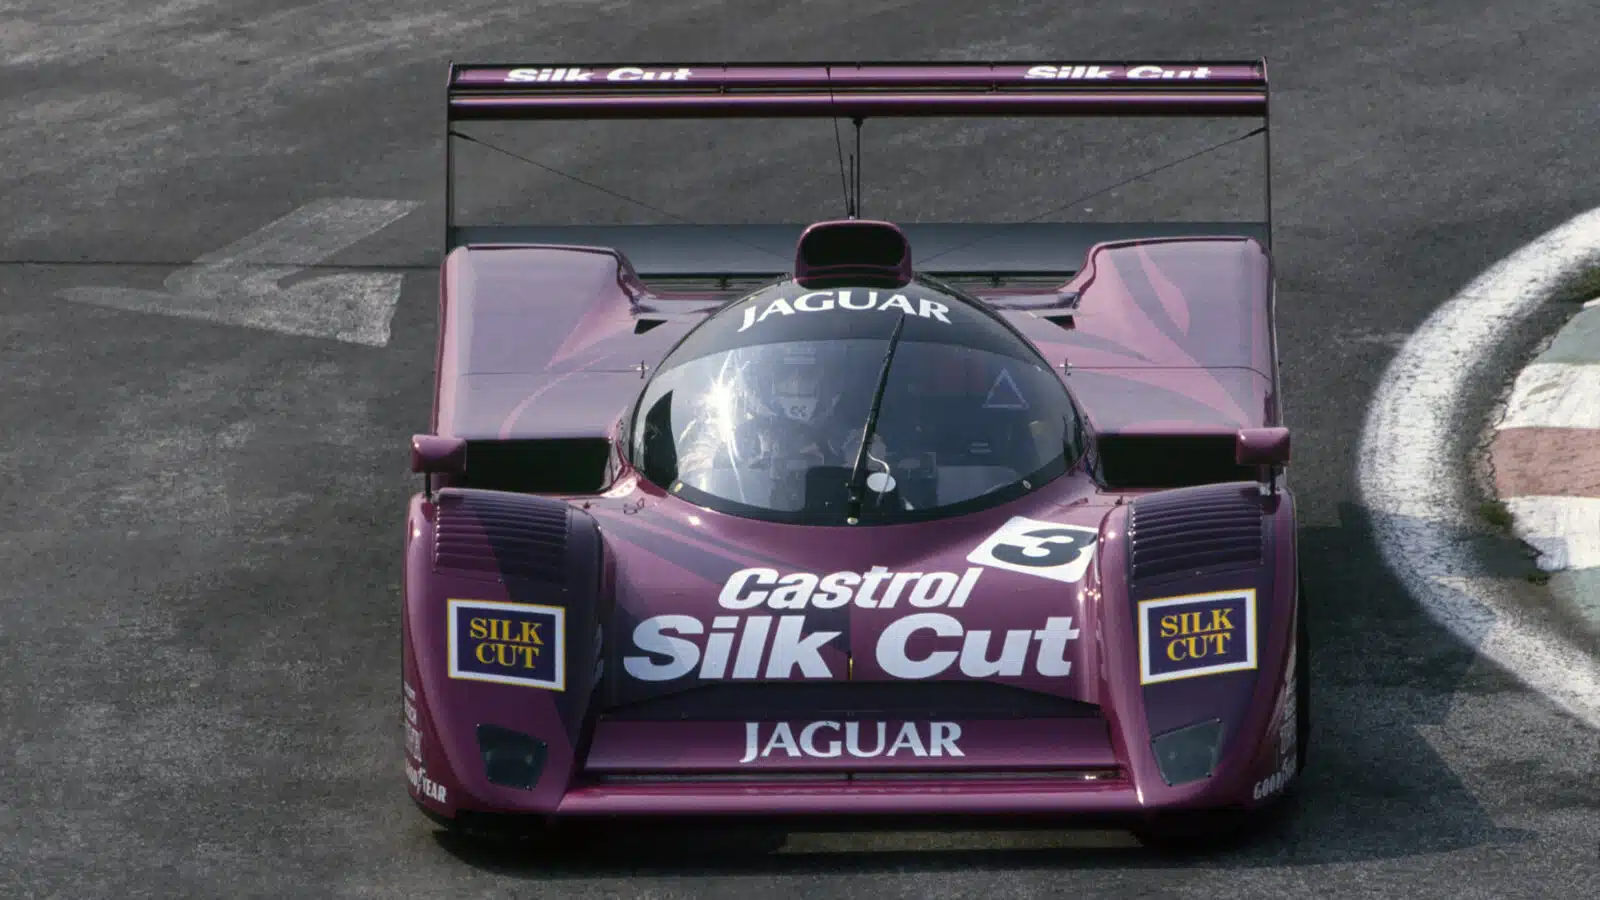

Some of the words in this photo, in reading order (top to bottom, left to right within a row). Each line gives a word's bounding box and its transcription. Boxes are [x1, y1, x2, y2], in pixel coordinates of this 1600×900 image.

[504, 67, 594, 82] Silk
[606, 66, 693, 82] Cut
[1024, 65, 1114, 79] Silk
[1126, 65, 1212, 79] Cut
[737, 290, 952, 333] JAGUAR
[991, 528, 1099, 568] 3
[718, 566, 985, 610] Castrol
[469, 616, 545, 645] SILK
[1159, 608, 1234, 638] SILK
[474, 642, 540, 669] CUT
[622, 614, 841, 682] Silk
[876, 613, 1080, 679] Cut
[1165, 631, 1231, 662] CUT
[739, 720, 966, 764] JAGUAR
